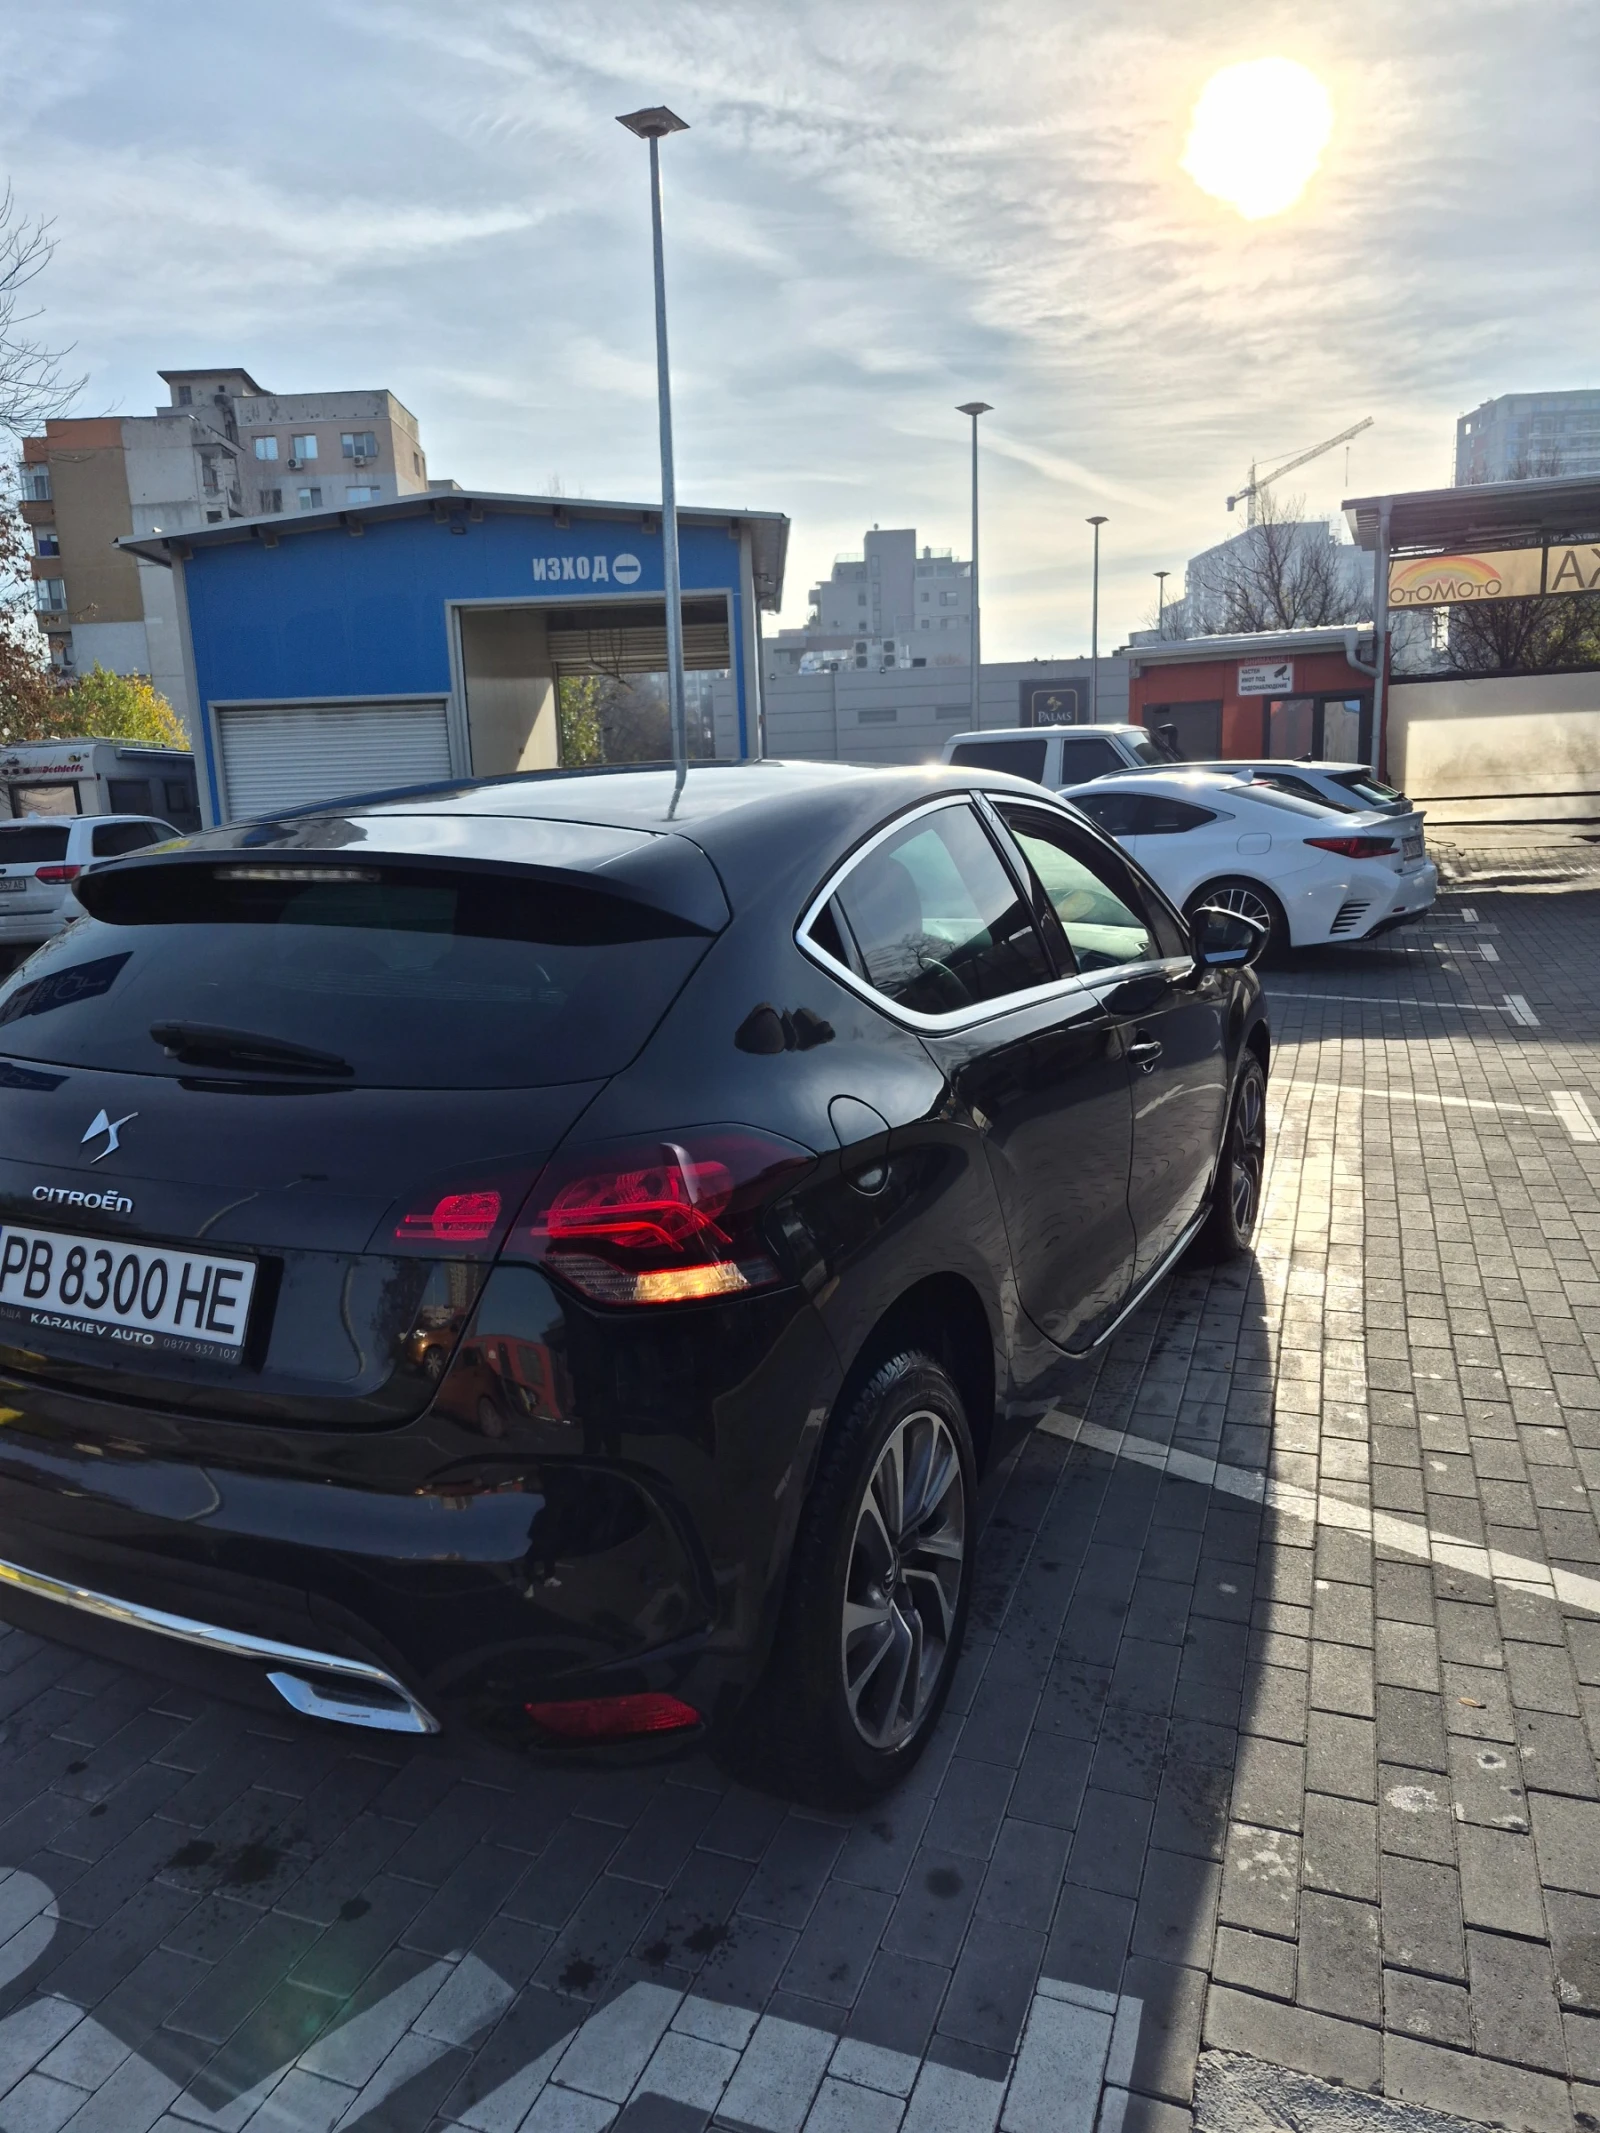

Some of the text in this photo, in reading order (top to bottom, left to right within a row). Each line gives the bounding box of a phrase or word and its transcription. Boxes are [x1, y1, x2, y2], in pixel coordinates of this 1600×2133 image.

[532, 555, 609, 582] ИЗХОД
[1038, 711, 1072, 723] PALMS
[41, 763, 84, 774] Dethleffs
[0, 1235, 244, 1335] PB 8300 HE
[30, 1313, 238, 1360] KARAKIEV AUTO 0877 937 107
